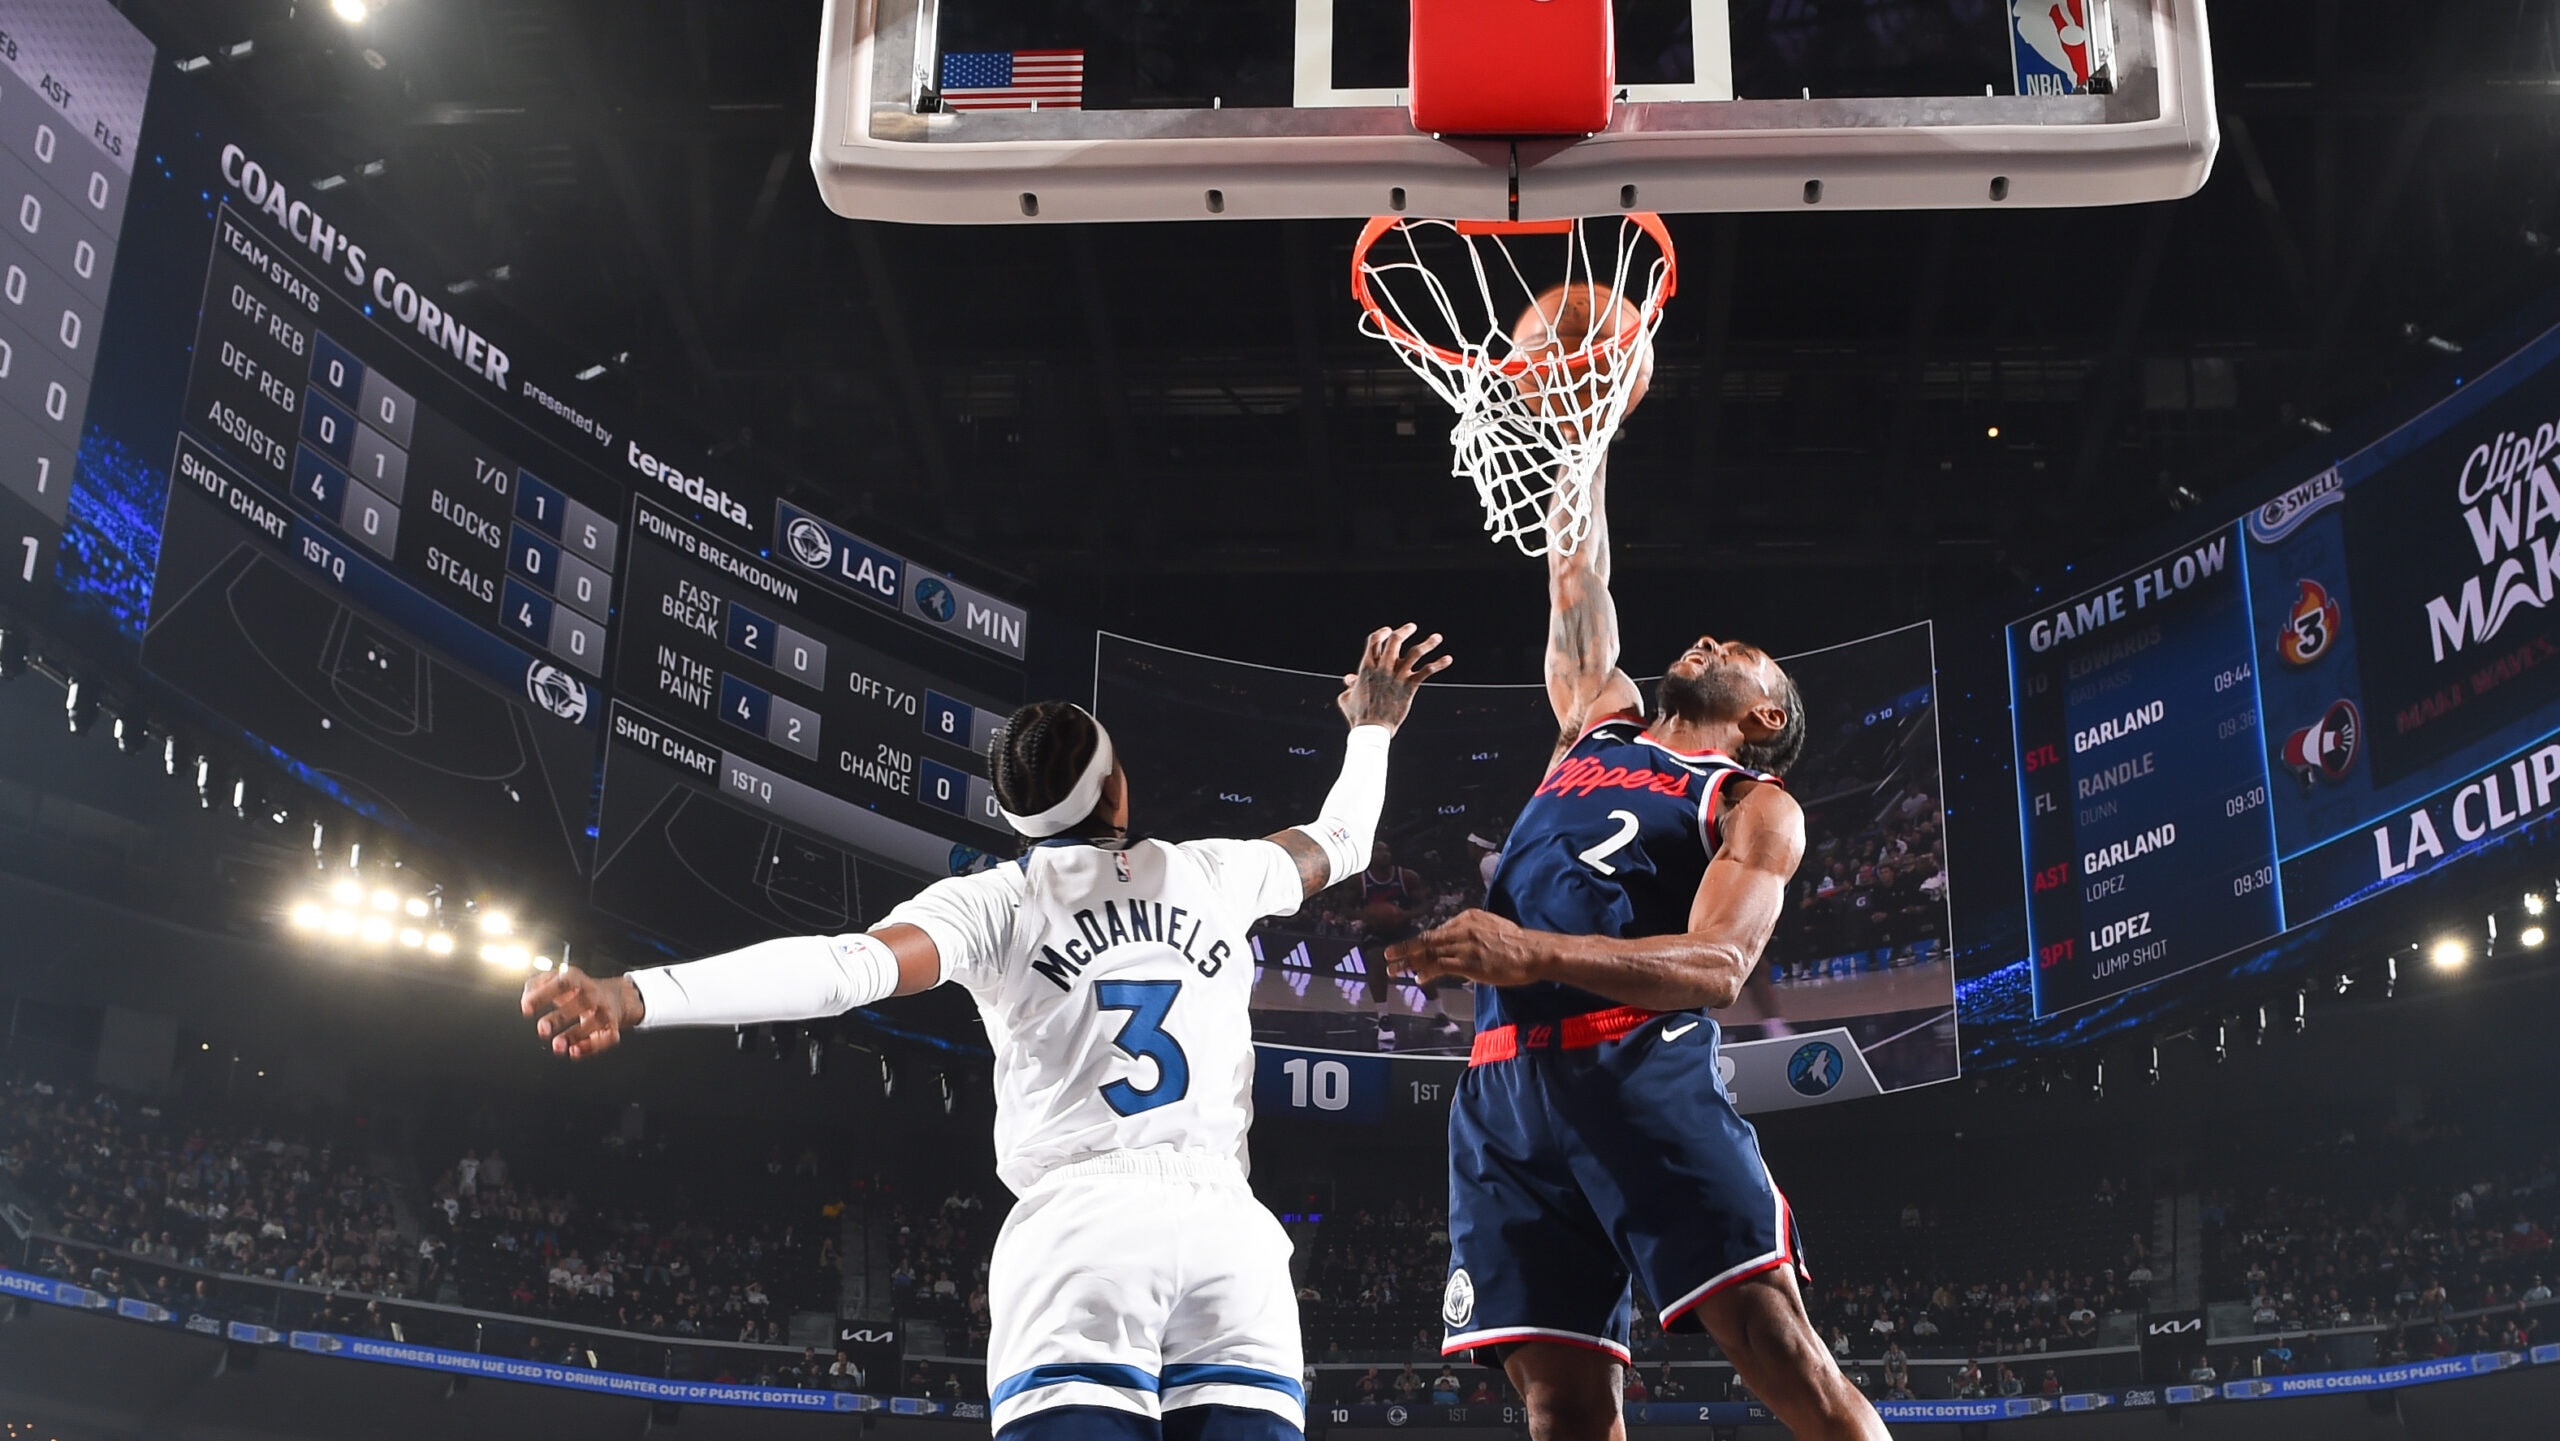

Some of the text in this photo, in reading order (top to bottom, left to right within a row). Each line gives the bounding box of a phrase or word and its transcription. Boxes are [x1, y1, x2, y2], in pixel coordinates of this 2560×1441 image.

[2026, 74, 2064, 95] NBA
[40, 73, 72, 109] AST
[94, 120, 121, 156] FLS
[35, 124, 109, 209] 0 0
[20, 194, 95, 278] 0 0
[224, 222, 320, 313] TEAM STATS
[6, 265, 81, 348] 0 0
[373, 267, 510, 391] CORNER
[232, 284, 396, 424] OFF REB 0 0
[46, 382, 67, 420] 0
[221, 341, 385, 480] DEF REB 0 1
[523, 381, 613, 447] presented by
[37, 457, 50, 493] 1
[209, 400, 379, 535] ASSISTS 4 0
[2458, 418, 2560, 505] Clipp
[475, 458, 597, 549] T/O 1 5
[2285, 466, 2339, 513] SWELL
[2463, 453, 2560, 566] WA
[181, 453, 346, 582] SHOT CHART 1ST Q
[22, 536, 39, 581] 1
[431, 489, 592, 601] BLOCKS 0 0
[639, 509, 798, 604] POINTS BREAKDOWN
[679, 580, 721, 616] FAST
[841, 548, 896, 597] LAC
[2029, 536, 2227, 653] GAME FLOW
[426, 547, 585, 655] STEALS 4 0
[966, 602, 1021, 648] MIN
[662, 594, 807, 672] BREAK 2 0
[2295, 606, 2328, 659] 3
[658, 645, 713, 689] IN THE
[2214, 662, 2252, 693] 09:44
[660, 669, 801, 743] PAINT 4 2
[850, 672, 955, 734] OFF T/O 8
[2074, 699, 2164, 753] GARLAND
[2218, 708, 2257, 740] 09:36
[615, 716, 773, 803] SHOT CHART 1ST Q
[840, 750, 998, 818] CHANCE 0 0
[877, 743, 912, 773] 2ND
[1534, 756, 1690, 797] Clippers
[2026, 744, 2059, 772] STL
[2078, 752, 2155, 800] RANDLE
[2035, 792, 2057, 816] FL
[2080, 786, 2266, 827] DUNN 09:30
[1578, 810, 1640, 876] 2
[2084, 823, 2176, 875] GARLAND
[2373, 808, 2444, 881] LA
[2034, 862, 2070, 893] AST
[2086, 865, 2273, 903] LOPEZ 09:30
[2039, 938, 2075, 969] 3PT
[2090, 912, 2151, 952] LOPEZ
[2092, 939, 2168, 980] JUMP SHOT
[1095, 979, 1190, 1117] 3
[1283, 1058, 1440, 1111] 10 1ST
[354, 1342, 826, 1406] REMEMBER WHEN WE USED TO DRINK WATER OUT OF PLASTIC BOTTLES?
[2283, 1362, 2467, 1391] MORE OCEAN. LESS PLASTIC.
[1330, 1406, 1527, 1423] 10 1ST 9:1
[1699, 1407, 1709, 1420] 2
[1884, 1405, 1934, 1418] PLASTIC
[1936, 1403, 1997, 1417] BOTTLES?
